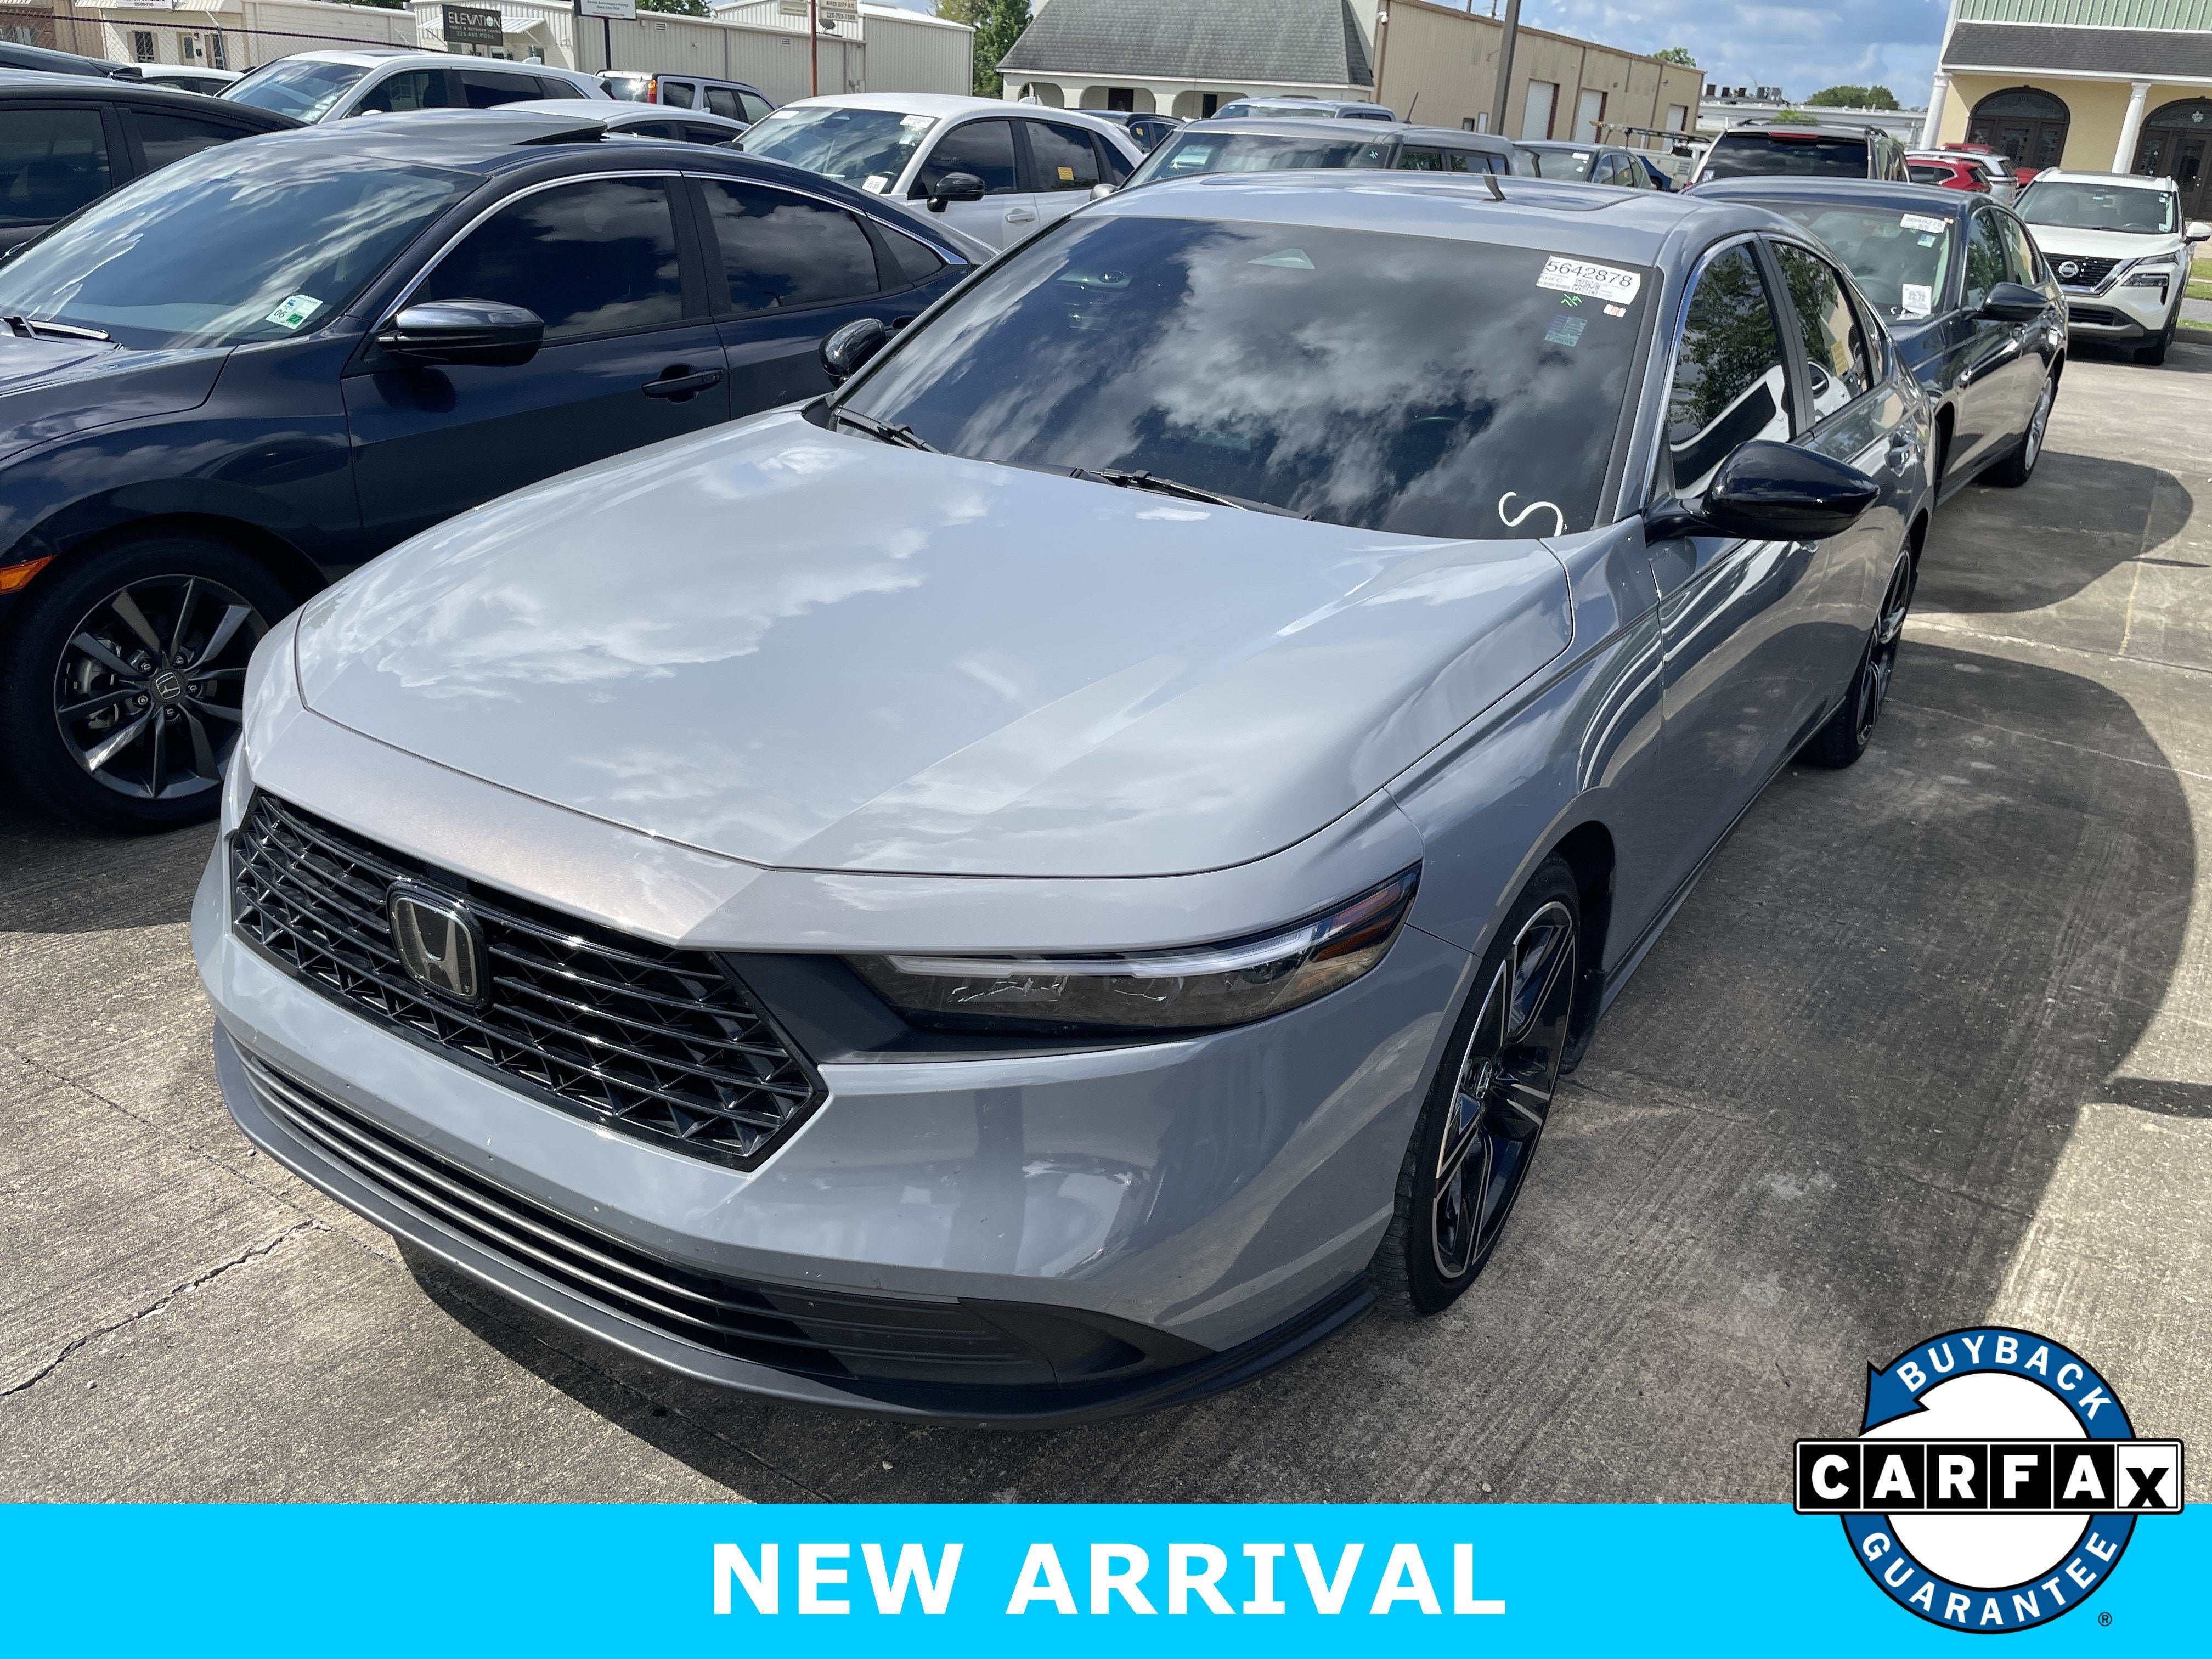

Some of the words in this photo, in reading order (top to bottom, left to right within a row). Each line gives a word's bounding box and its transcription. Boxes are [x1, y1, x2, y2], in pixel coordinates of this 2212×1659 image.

[448, 11, 501, 28] ELEVATION
[1545, 261, 1633, 287] 5642878
[274, 309, 287, 318] 06
[288, 314, 303, 323] 27
